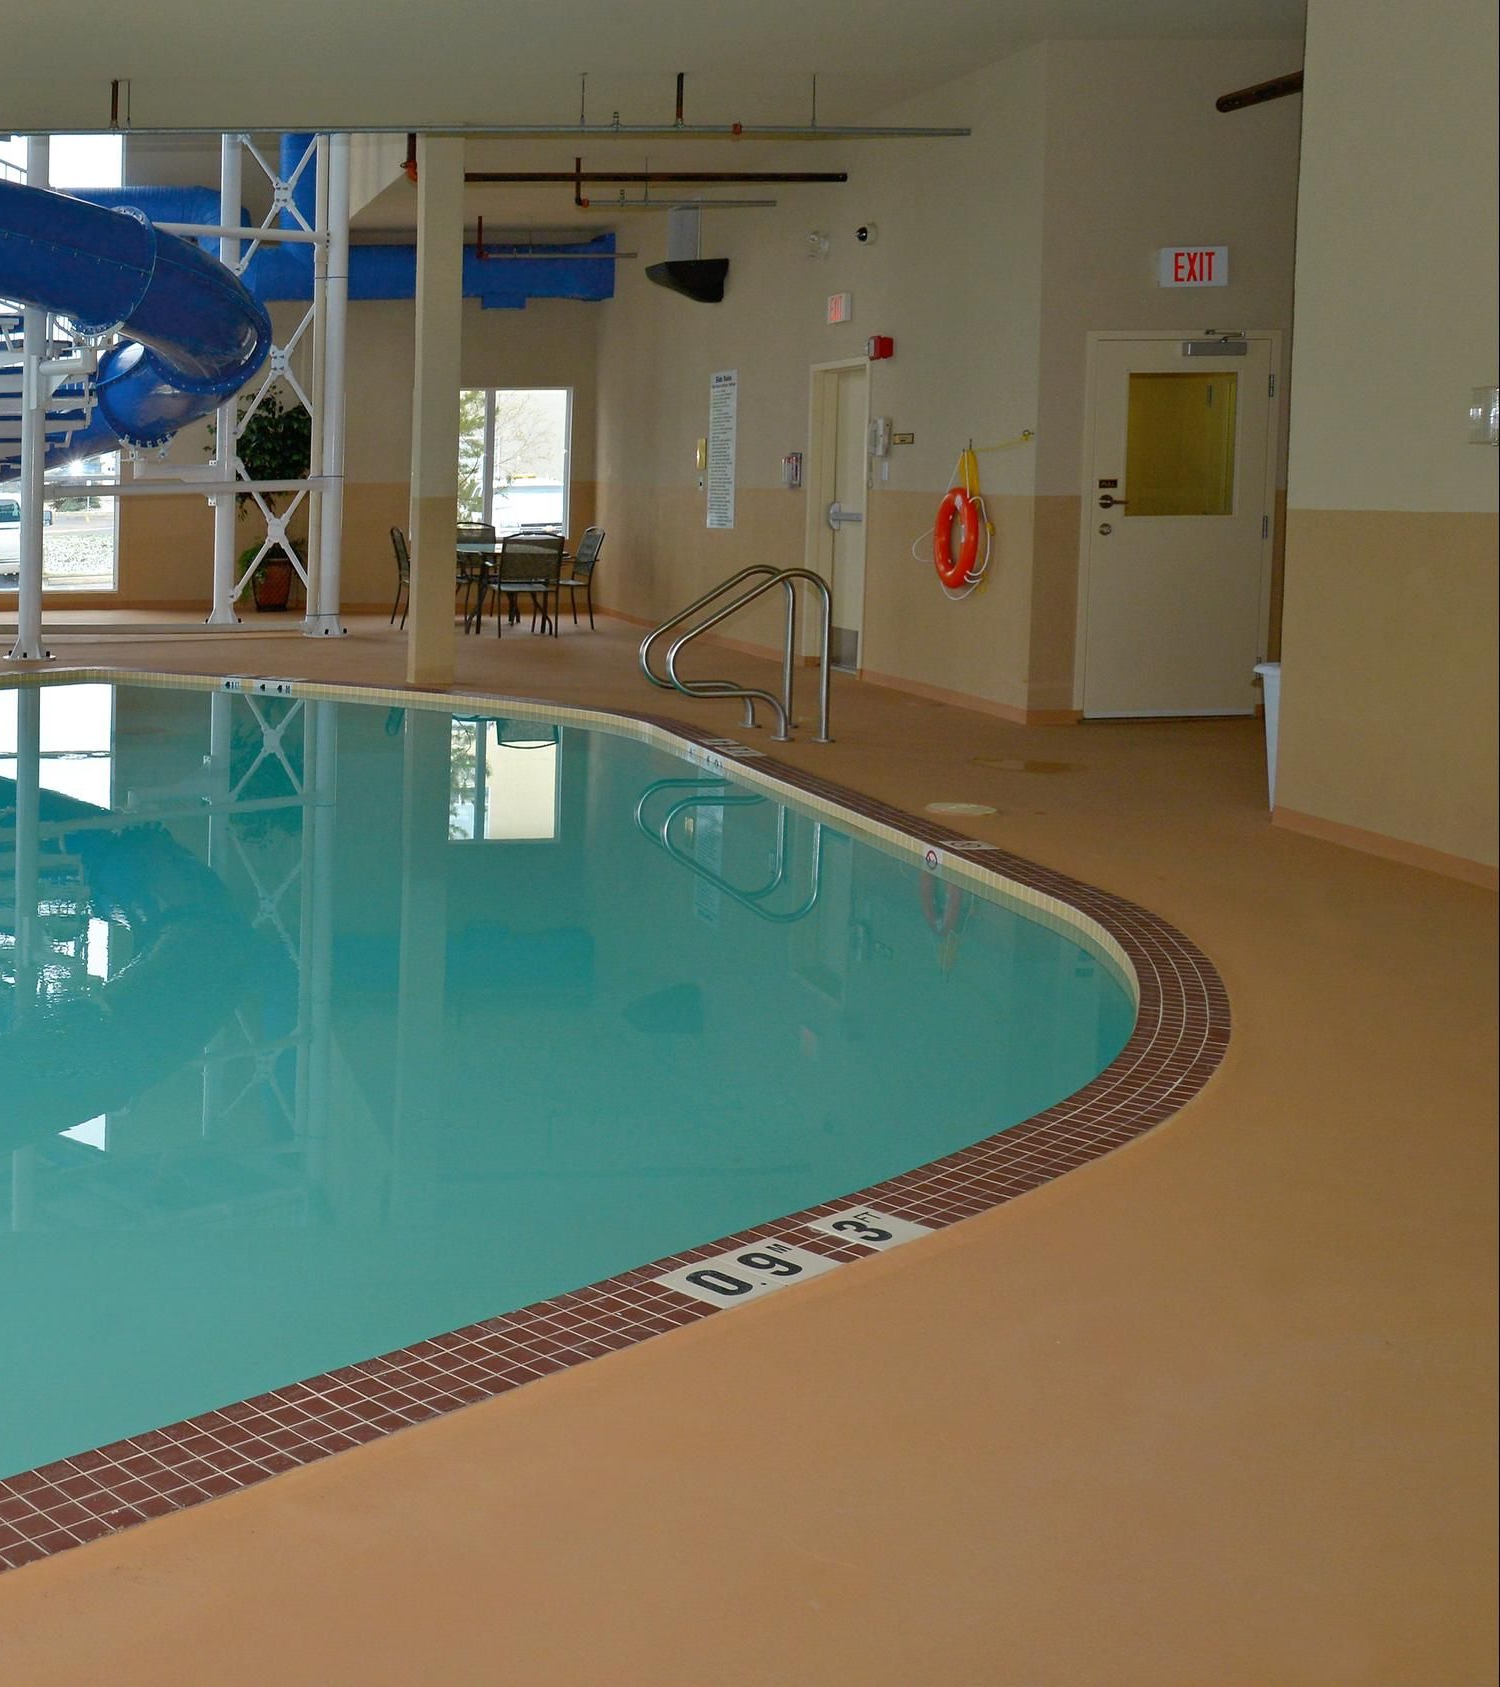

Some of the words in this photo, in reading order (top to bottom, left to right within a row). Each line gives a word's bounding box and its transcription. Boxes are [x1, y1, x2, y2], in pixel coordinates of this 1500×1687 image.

[1173, 252, 1216, 283] EXIT
[853, 1210, 884, 1224] FT
[831, 1219, 894, 1243] 3
[685, 1252, 803, 1297] 0.9
[765, 1242, 794, 1255] M
